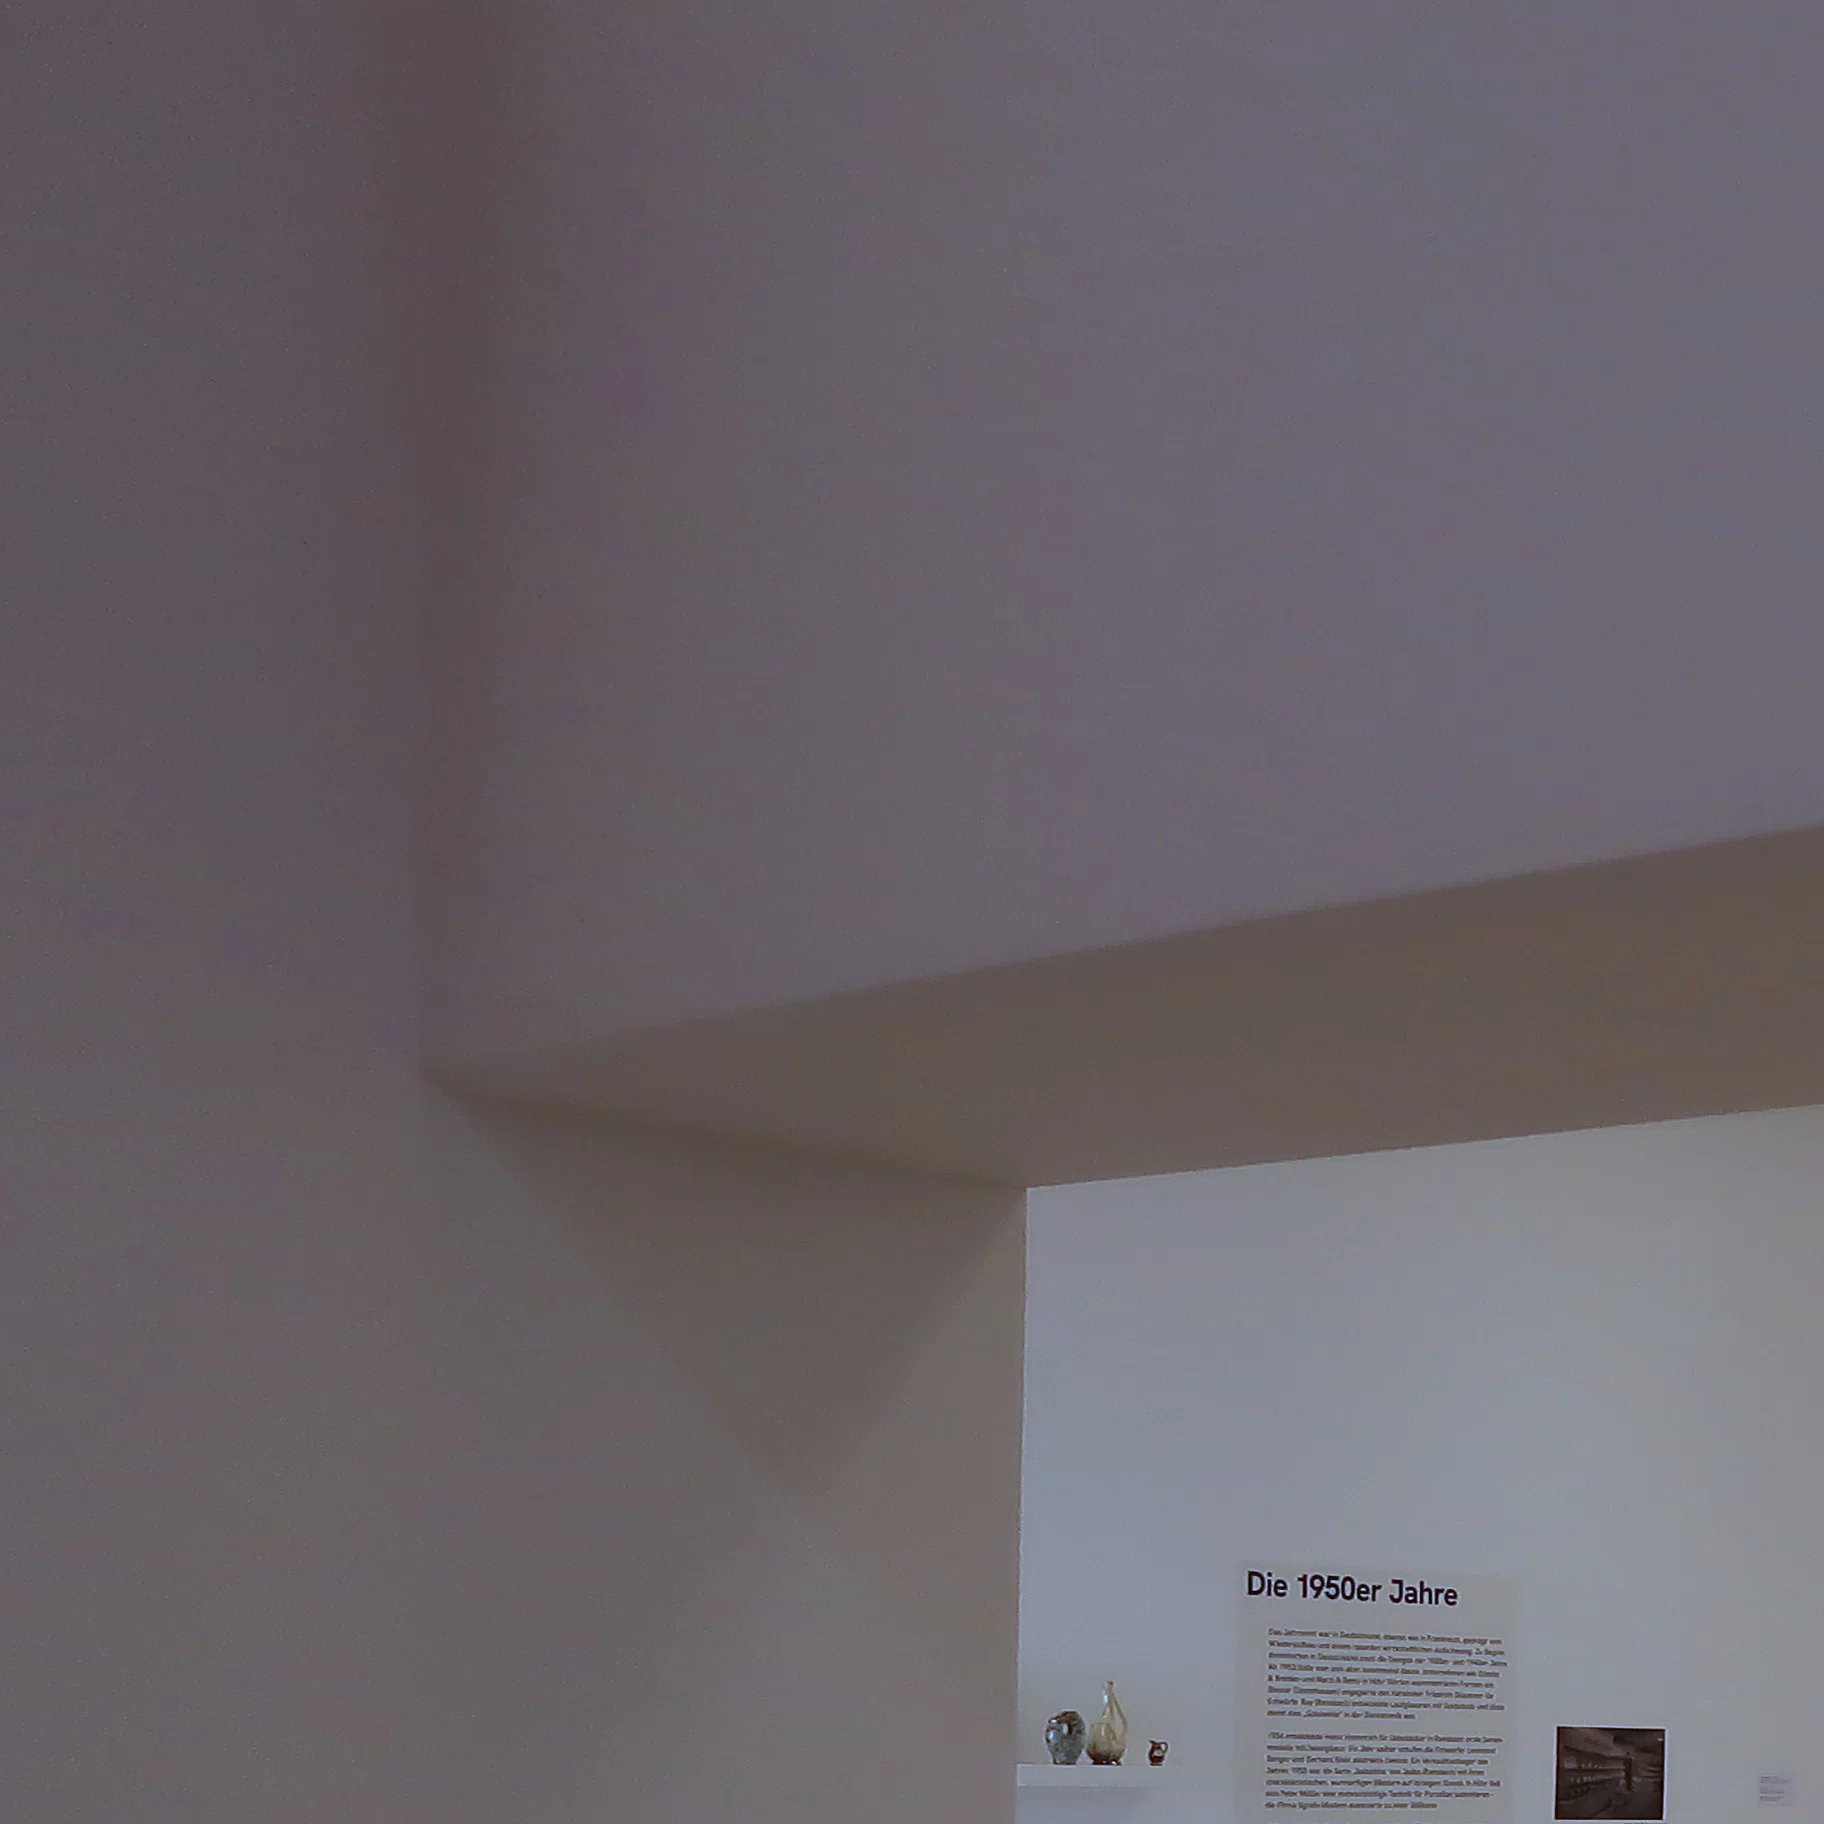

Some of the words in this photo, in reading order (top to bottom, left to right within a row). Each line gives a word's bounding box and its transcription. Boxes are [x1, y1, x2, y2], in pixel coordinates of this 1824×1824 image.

[1247, 1570, 1288, 1598] Die
[1297, 1573, 1383, 1602] 1950er
[1388, 1578, 1458, 1607] Jahre
